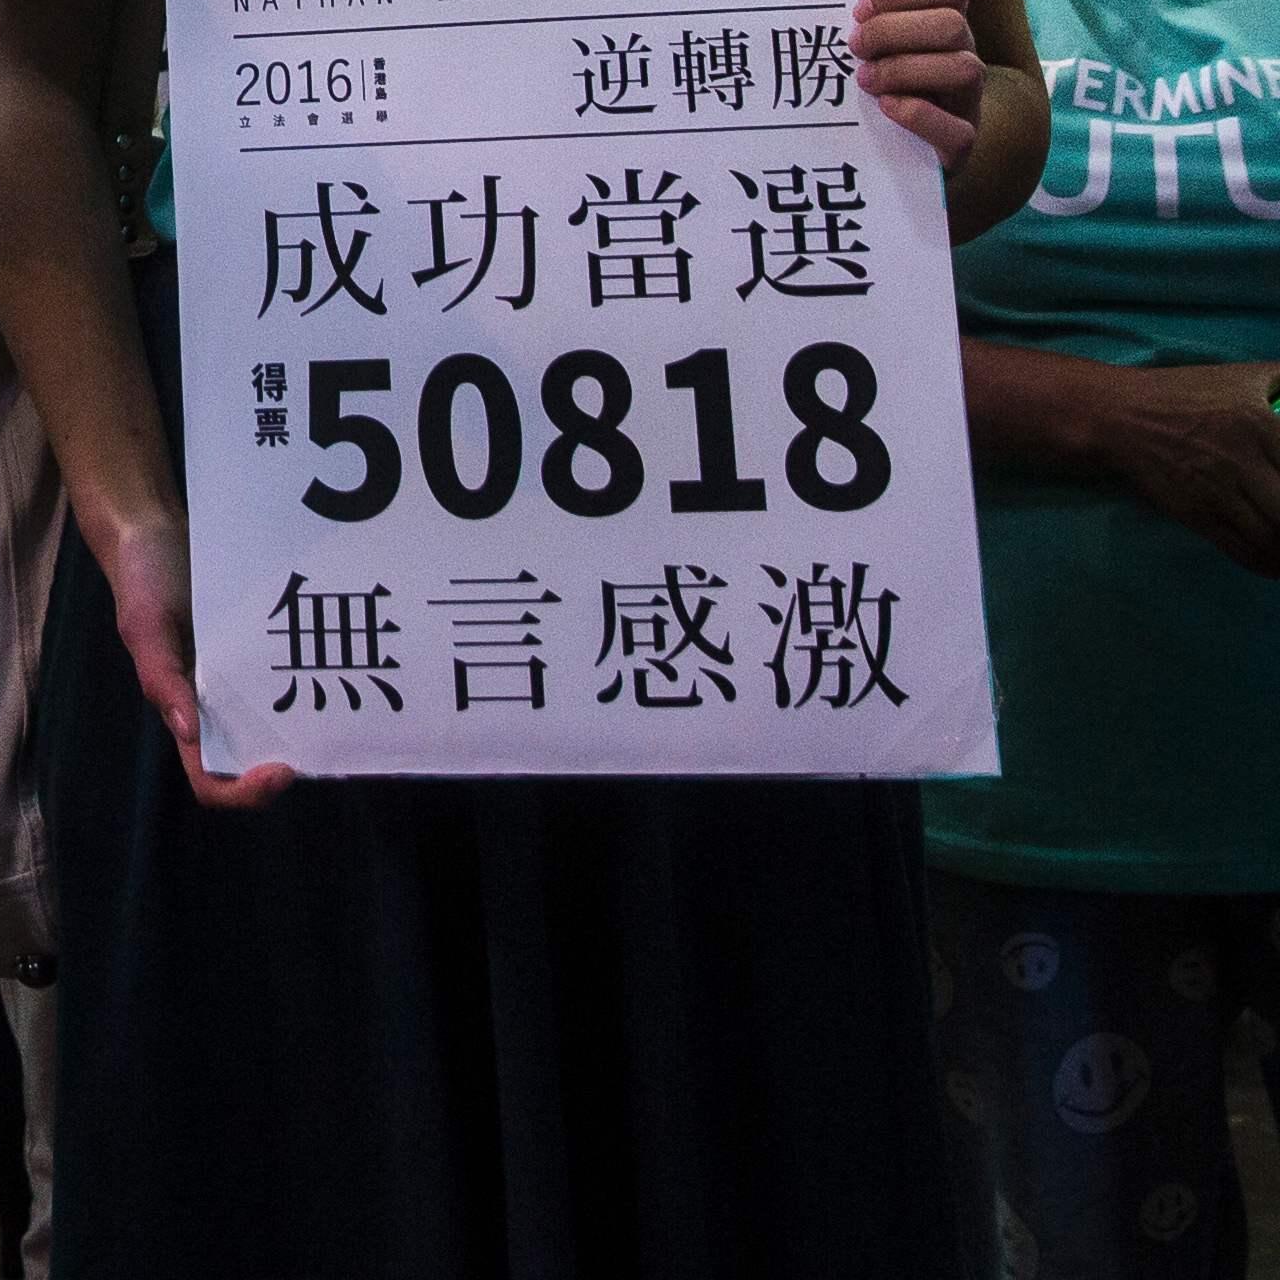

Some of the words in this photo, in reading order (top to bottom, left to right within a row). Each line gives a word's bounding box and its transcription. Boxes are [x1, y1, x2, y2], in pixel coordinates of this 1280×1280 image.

[235, 57, 353, 107] 2016
[570, 22, 858, 120] 逆轉勝
[255, 161, 877, 322] 成功當選
[251, 361, 292, 450] 得票
[300, 340, 893, 525] 50818
[265, 560, 913, 715] 無言感激
